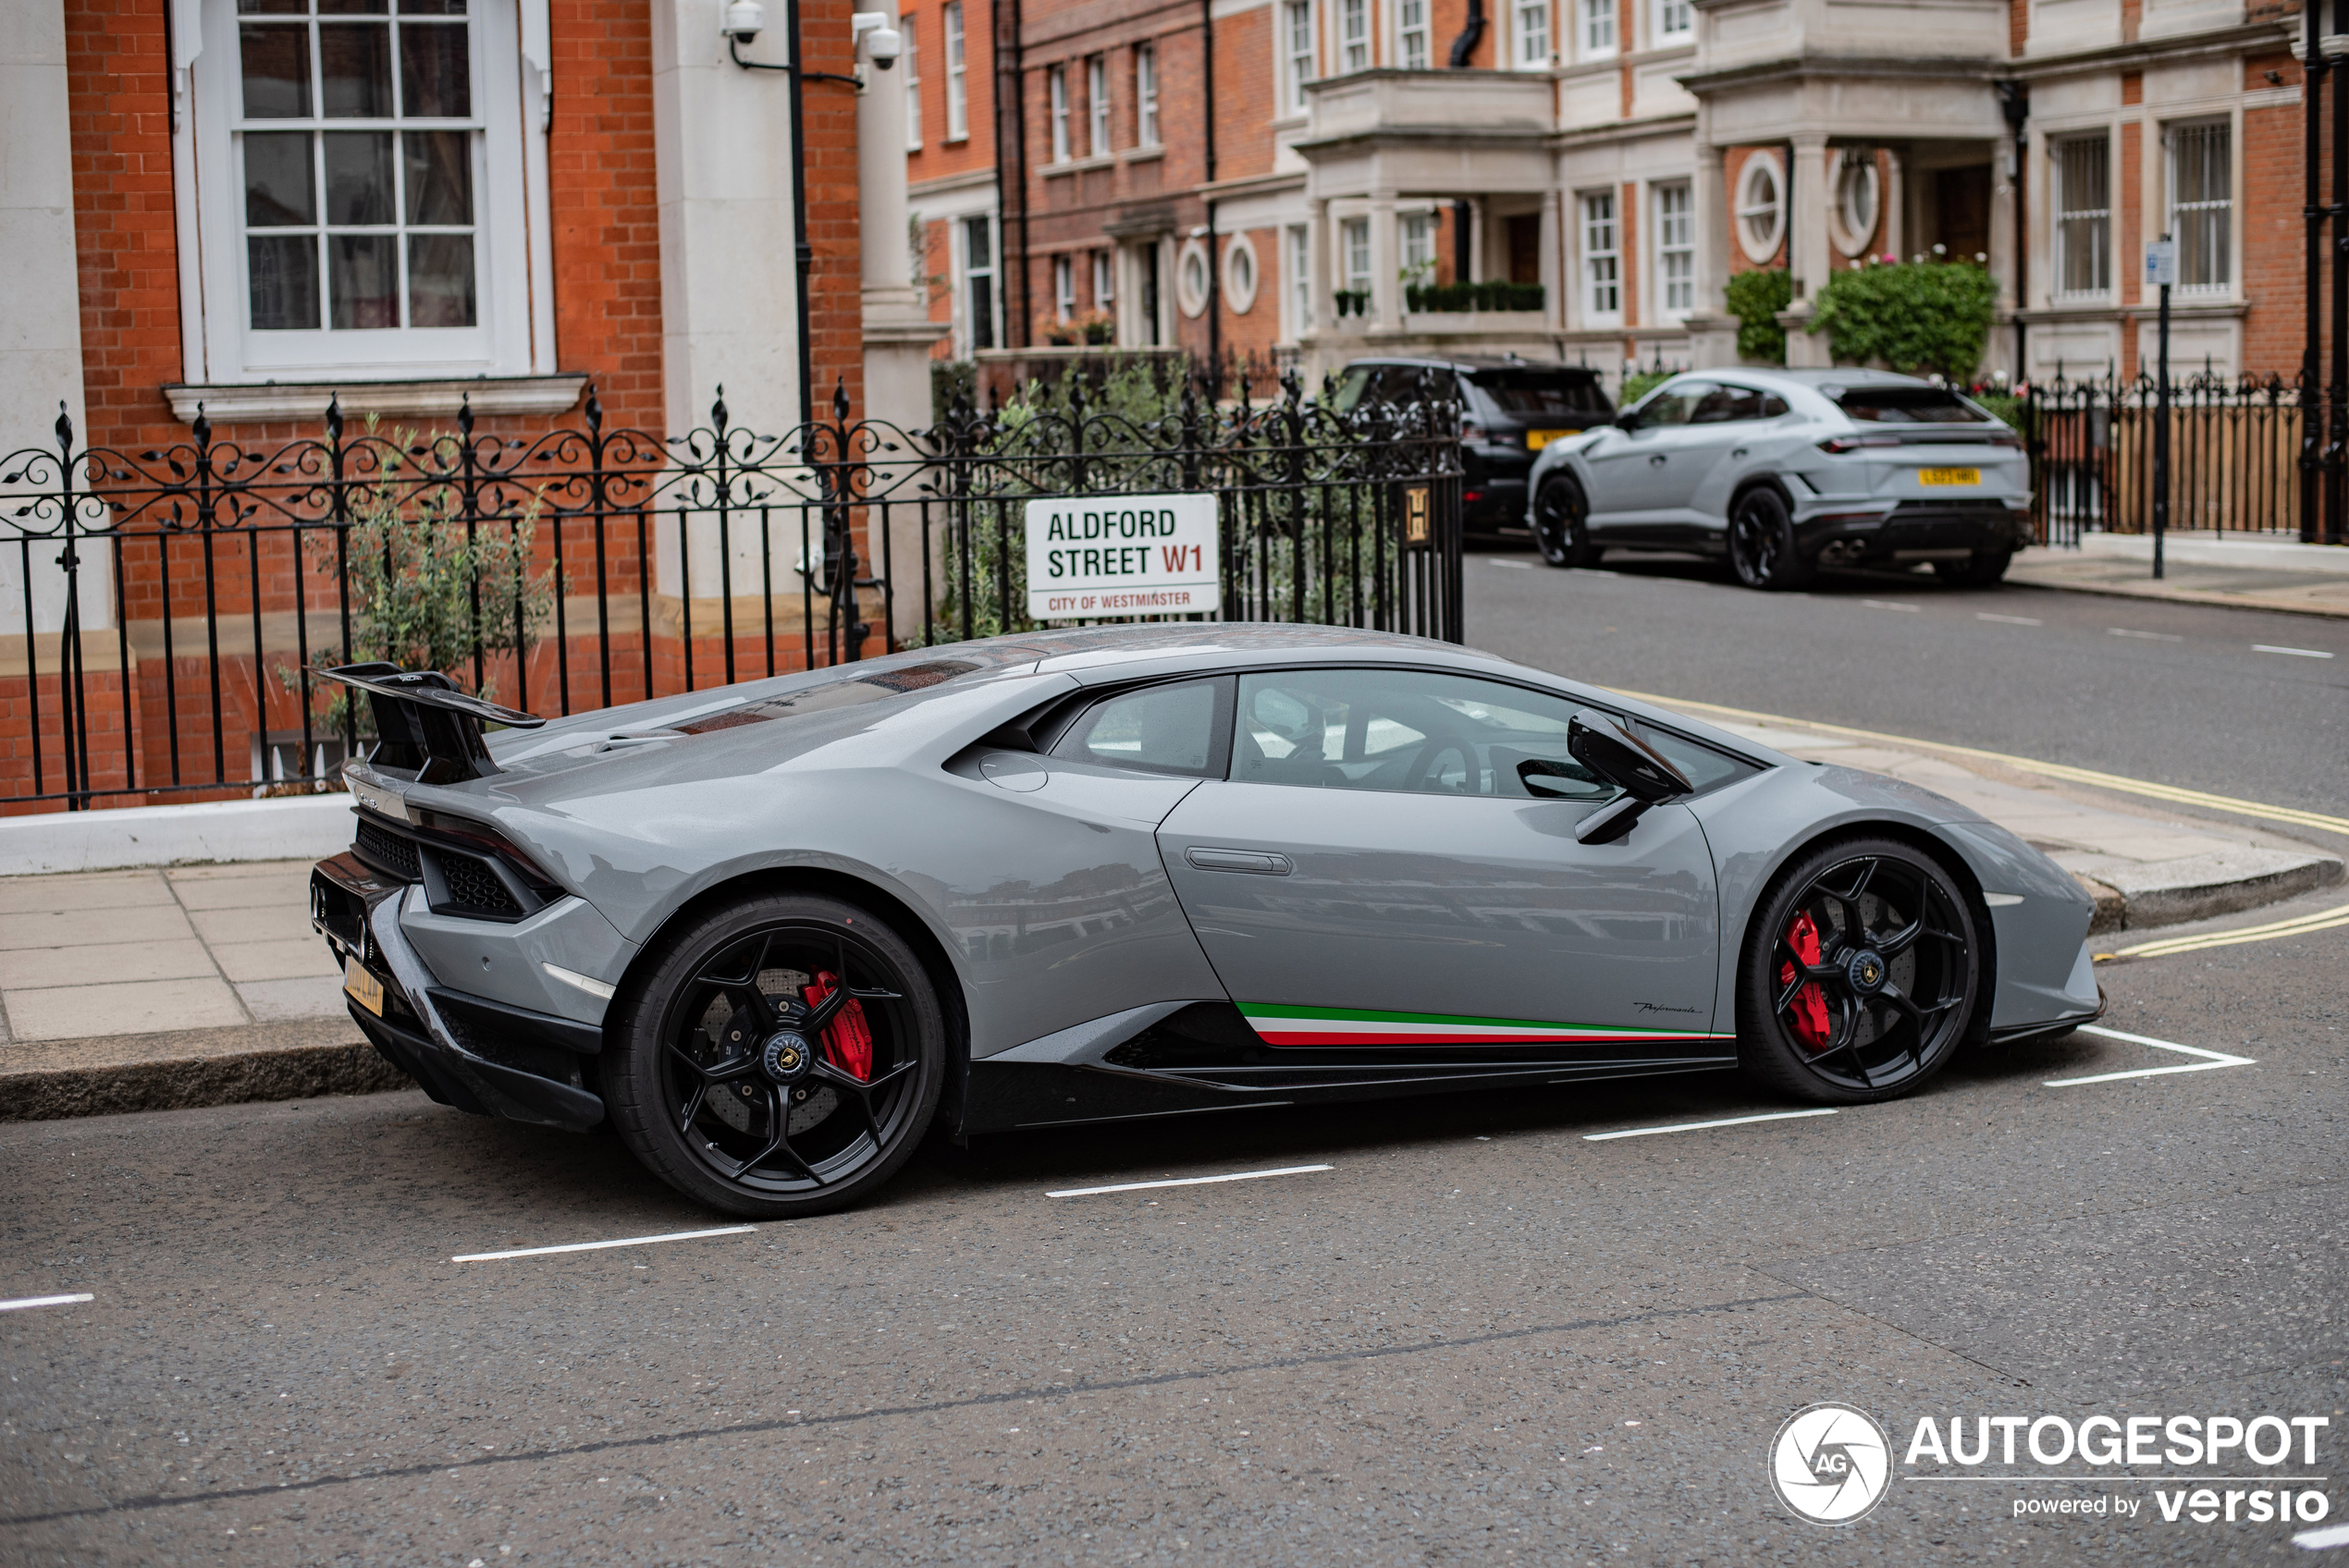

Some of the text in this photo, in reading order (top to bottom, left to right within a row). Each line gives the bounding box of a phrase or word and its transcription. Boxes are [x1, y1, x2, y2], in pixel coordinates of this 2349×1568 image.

[1048, 509, 1175, 541] ALDFORD
[1048, 545, 1201, 578] STREET W1
[1049, 592, 1190, 611] CITY OF WESTMINSTER
[1633, 1002, 1703, 1014] Performante
[843, 1007, 864, 1056] Lamborghini
